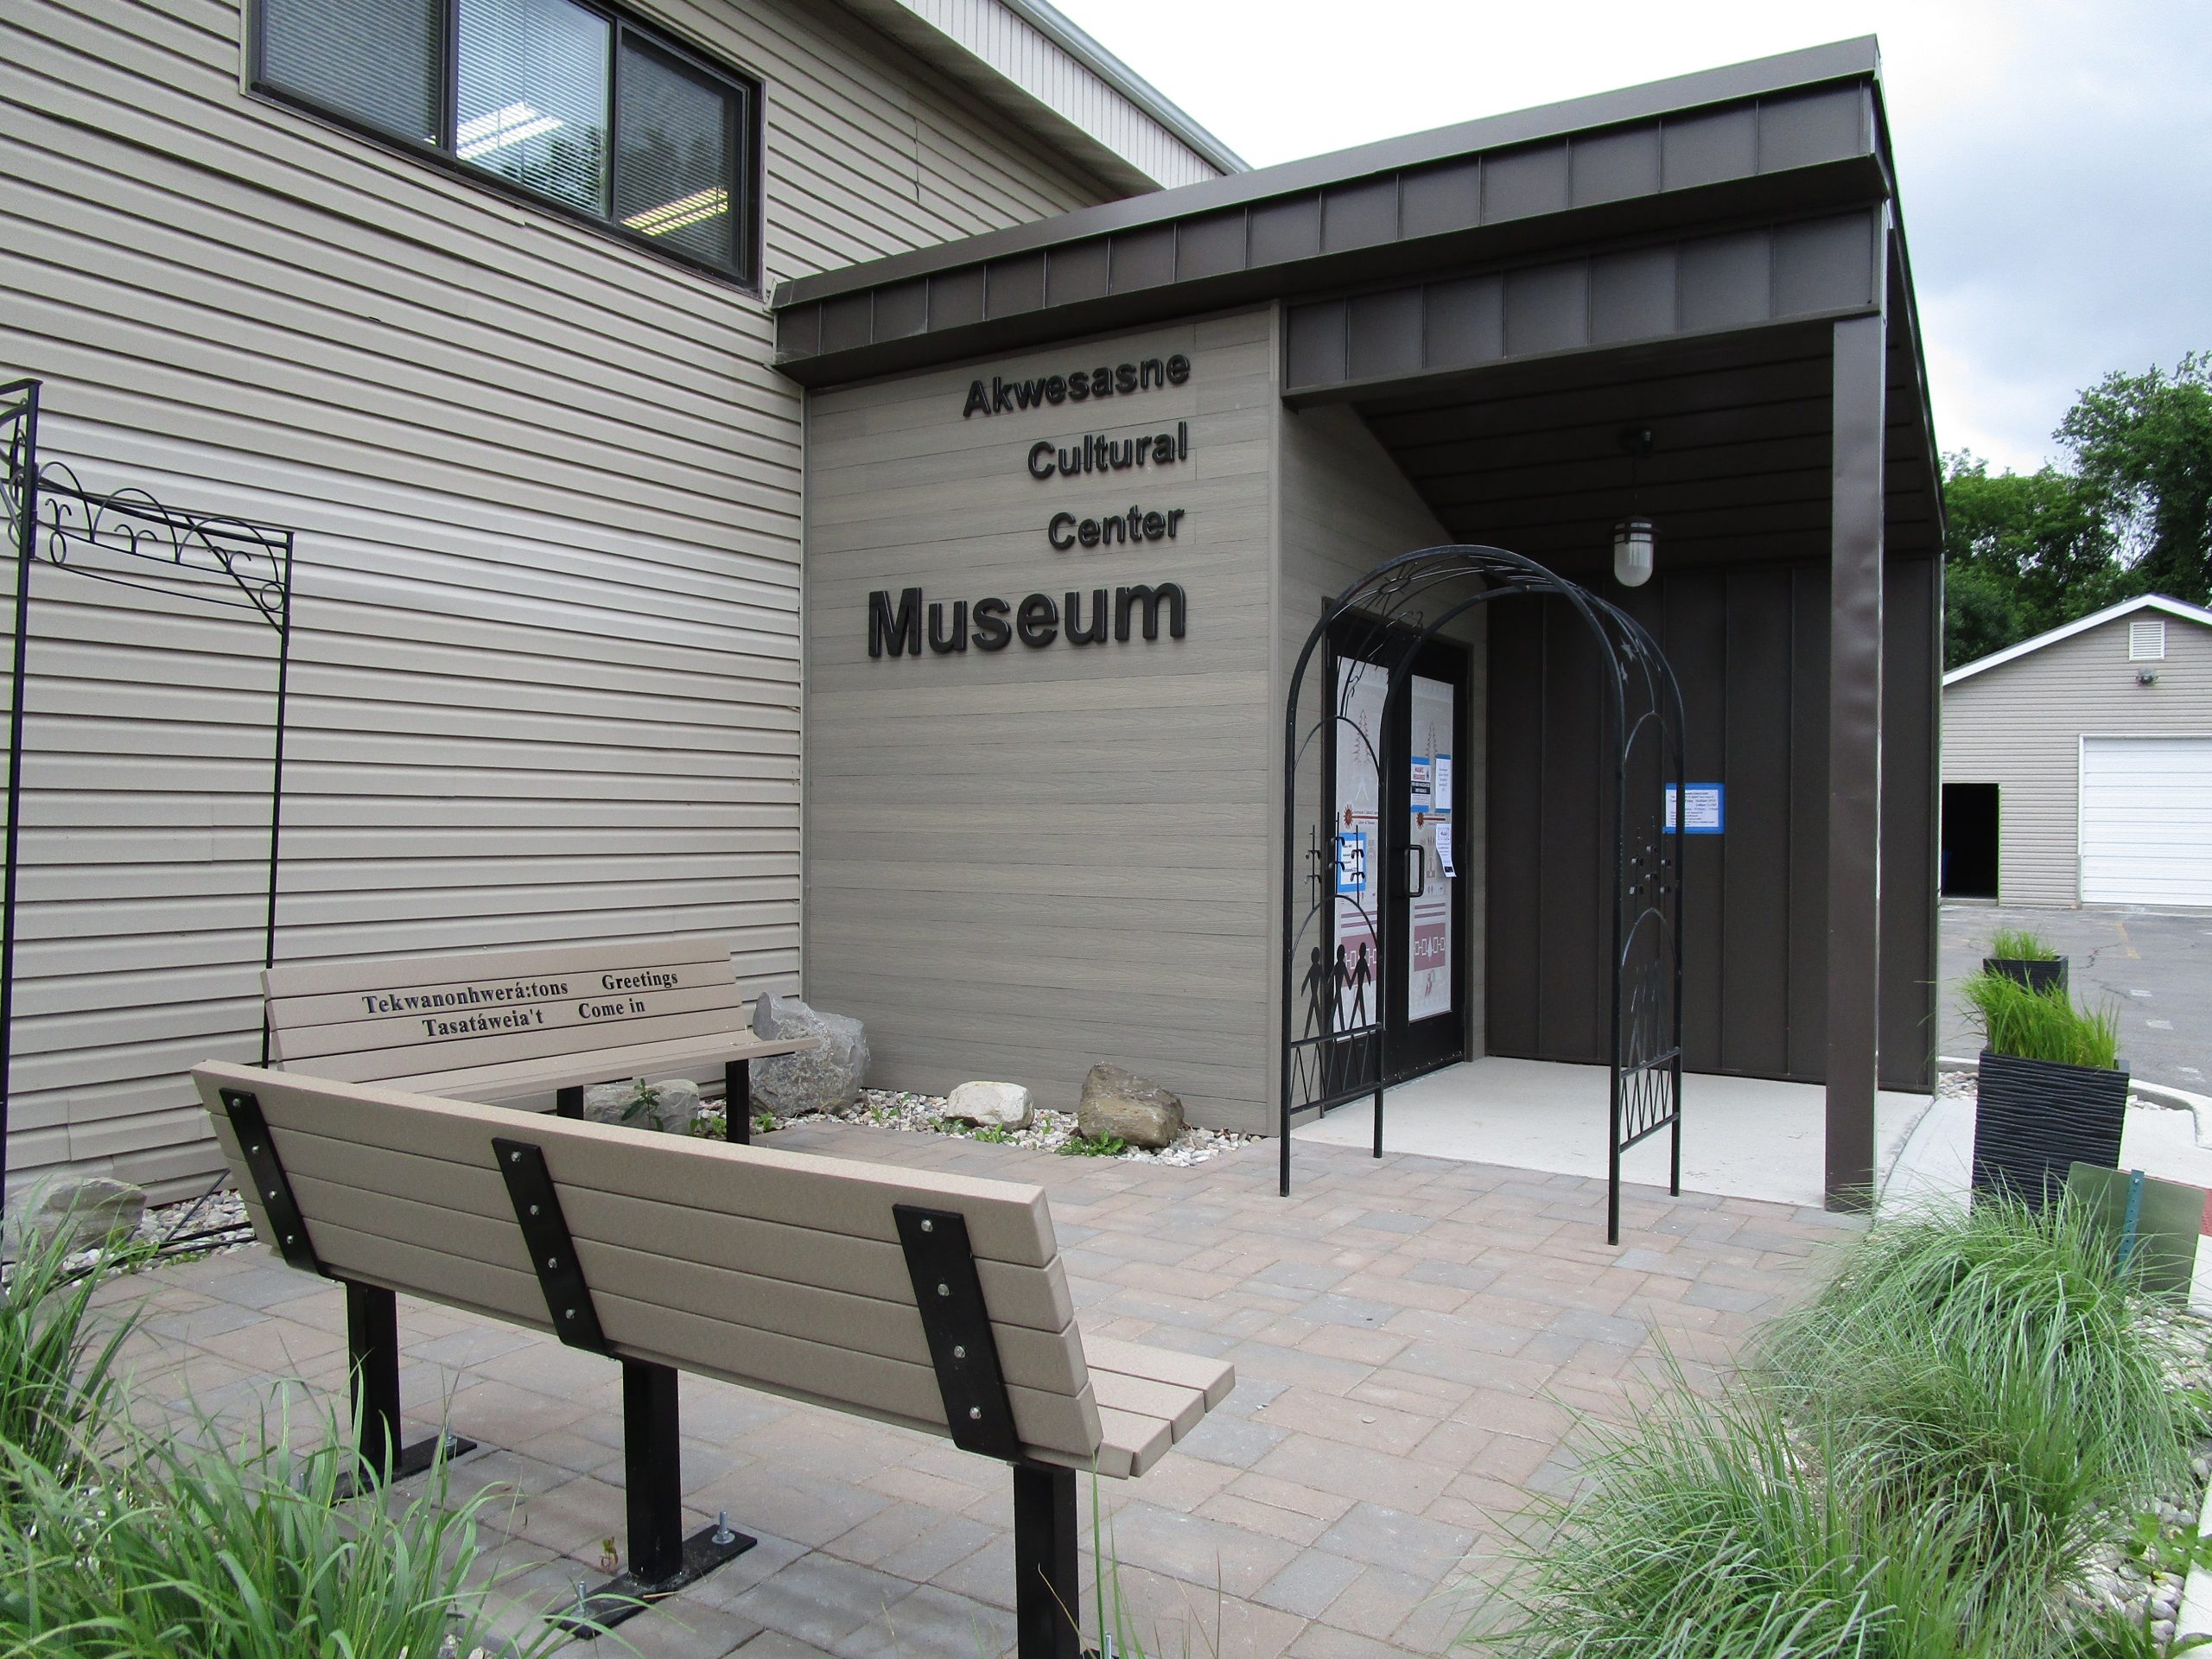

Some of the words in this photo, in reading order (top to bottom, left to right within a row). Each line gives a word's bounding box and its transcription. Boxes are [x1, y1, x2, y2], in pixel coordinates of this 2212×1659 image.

[962, 353, 1191, 418] Akwesasne
[1027, 420, 1187, 480] Cultural
[1047, 504, 1185, 550] Center
[868, 580, 1186, 658] Museum
[362, 981, 569, 1014] Tekwanonhwerá:tons
[601, 971, 678, 990] Greetings
[422, 1007, 543, 1037] Tasatáweia't
[578, 1001, 624, 1020] Come
[629, 997, 645, 1013] in
